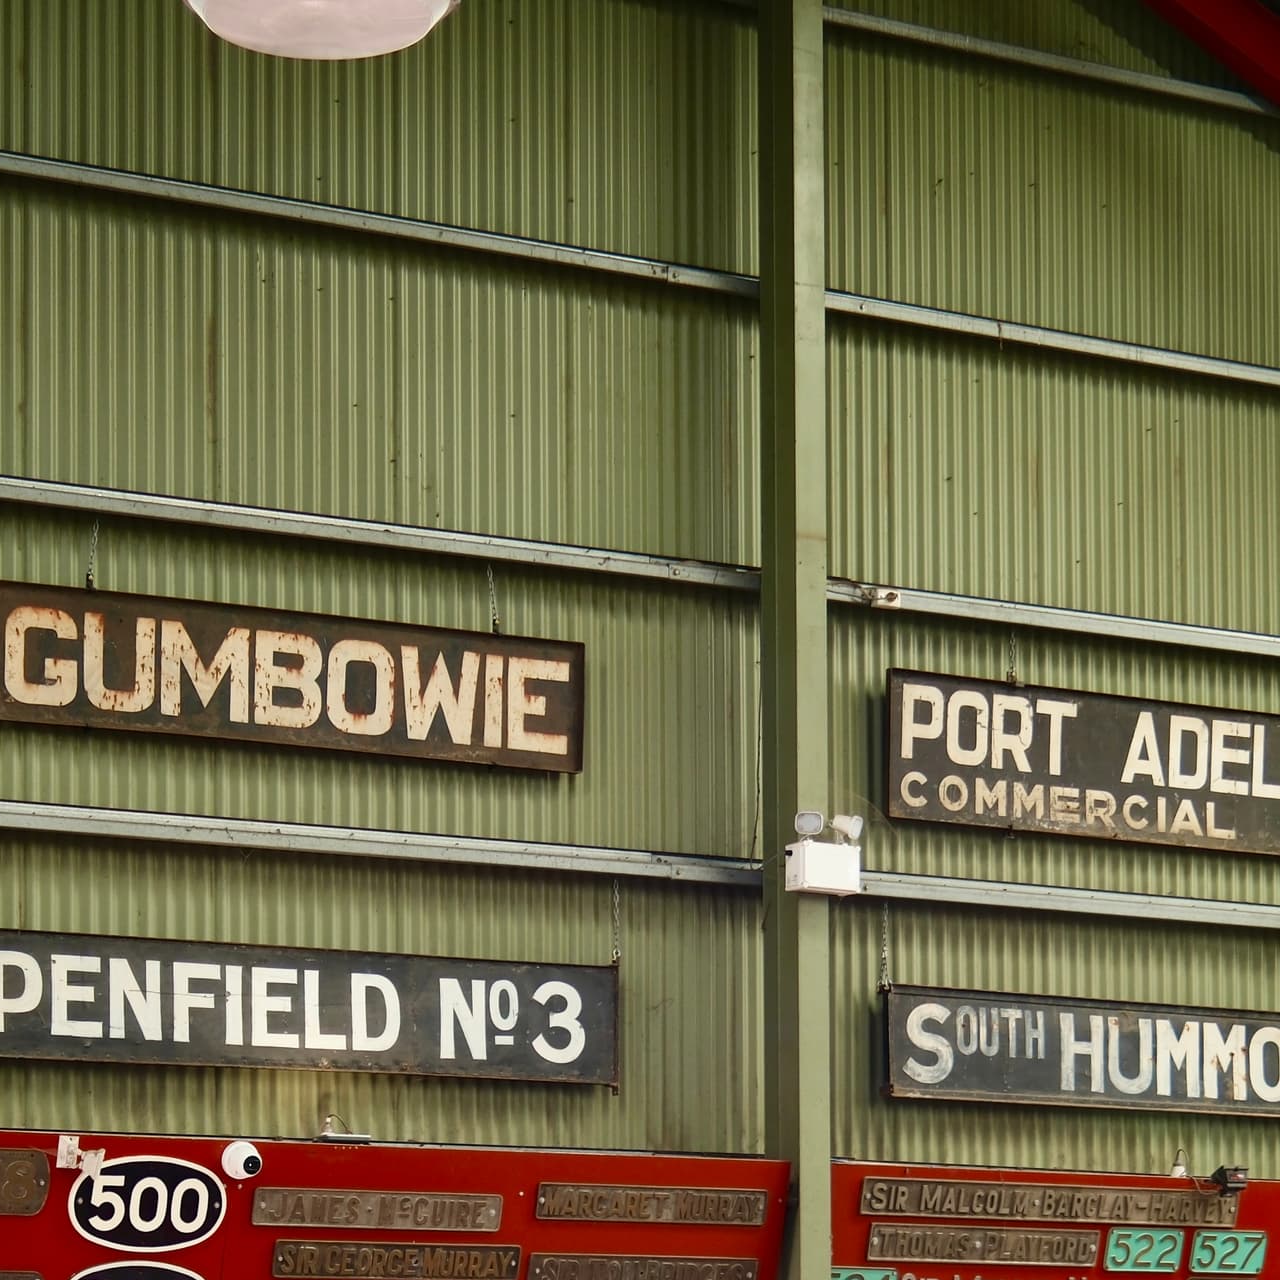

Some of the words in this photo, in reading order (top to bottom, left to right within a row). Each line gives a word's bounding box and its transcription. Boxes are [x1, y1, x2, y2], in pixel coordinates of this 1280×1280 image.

[3, 606, 570, 756] GUMBOWIE
[900, 683, 1078, 777] PORT
[900, 772, 1236, 840] COMMERCIAL
[902, 1003, 1045, 1085] SOUTH
[88, 1174, 209, 1234] 500
[268, 1191, 361, 1224] JAMES
[674, 1192, 761, 1222] MURRAY
[871, 1182, 909, 1212] SIR
[921, 1184, 1029, 1217] MALCOLM
[280, 1245, 319, 1275] SIR
[325, 1246, 419, 1276] GEORGE
[422, 1248, 515, 1279] MURRAY
[878, 1229, 970, 1259] THOMAS
[985, 1231, 1091, 1263] PLAYFORD
[1111, 1233, 1178, 1269] 522
[1196, 1234, 1265, 1270] 527
